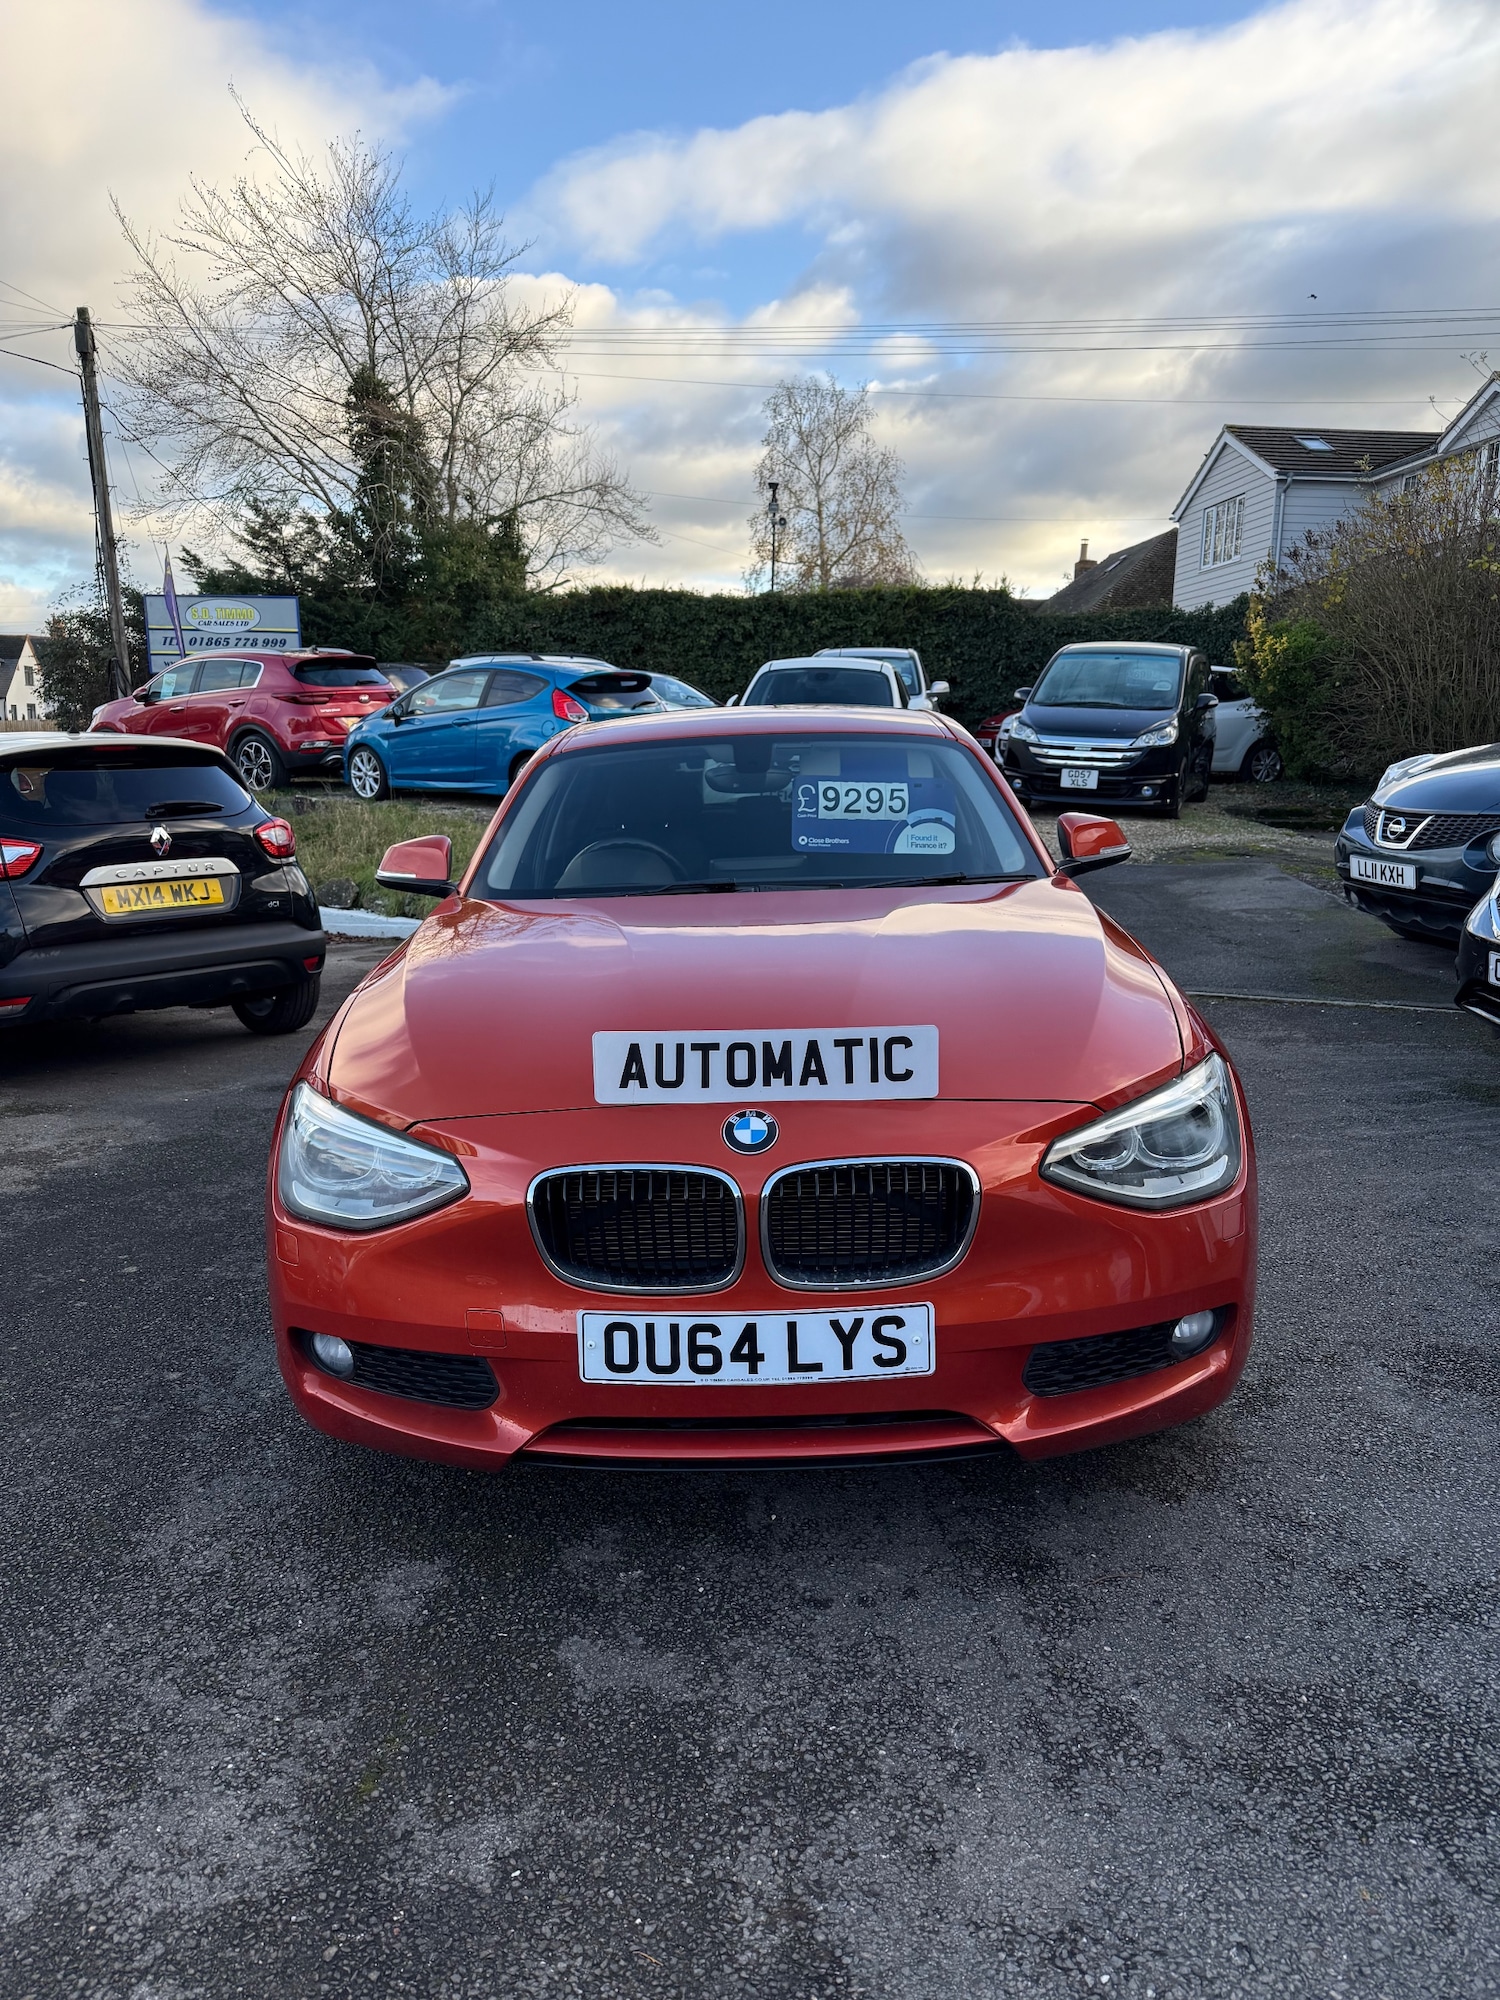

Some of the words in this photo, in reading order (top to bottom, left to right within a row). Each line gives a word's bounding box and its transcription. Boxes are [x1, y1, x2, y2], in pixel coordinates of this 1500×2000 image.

[215, 608, 255, 620] TIMMO
[162, 636, 180, 646] TE
[189, 637, 230, 647] 01865
[234, 637, 258, 647] 778
[261, 637, 287, 648] 999
[1070, 779, 1088, 787] XLS
[910, 841, 937, 849] Finance
[115, 862, 215, 879] CAPTUR
[1357, 859, 1377, 880] LL11
[1380, 863, 1404, 885] KXH
[115, 885, 165, 909] MX14
[169, 881, 211, 903] WKJ
[618, 1035, 915, 1089] AUTOMATIC
[729, 1110, 774, 1125] BMW
[603, 1321, 765, 1375] OU64
[787, 1315, 908, 1373] LYS
